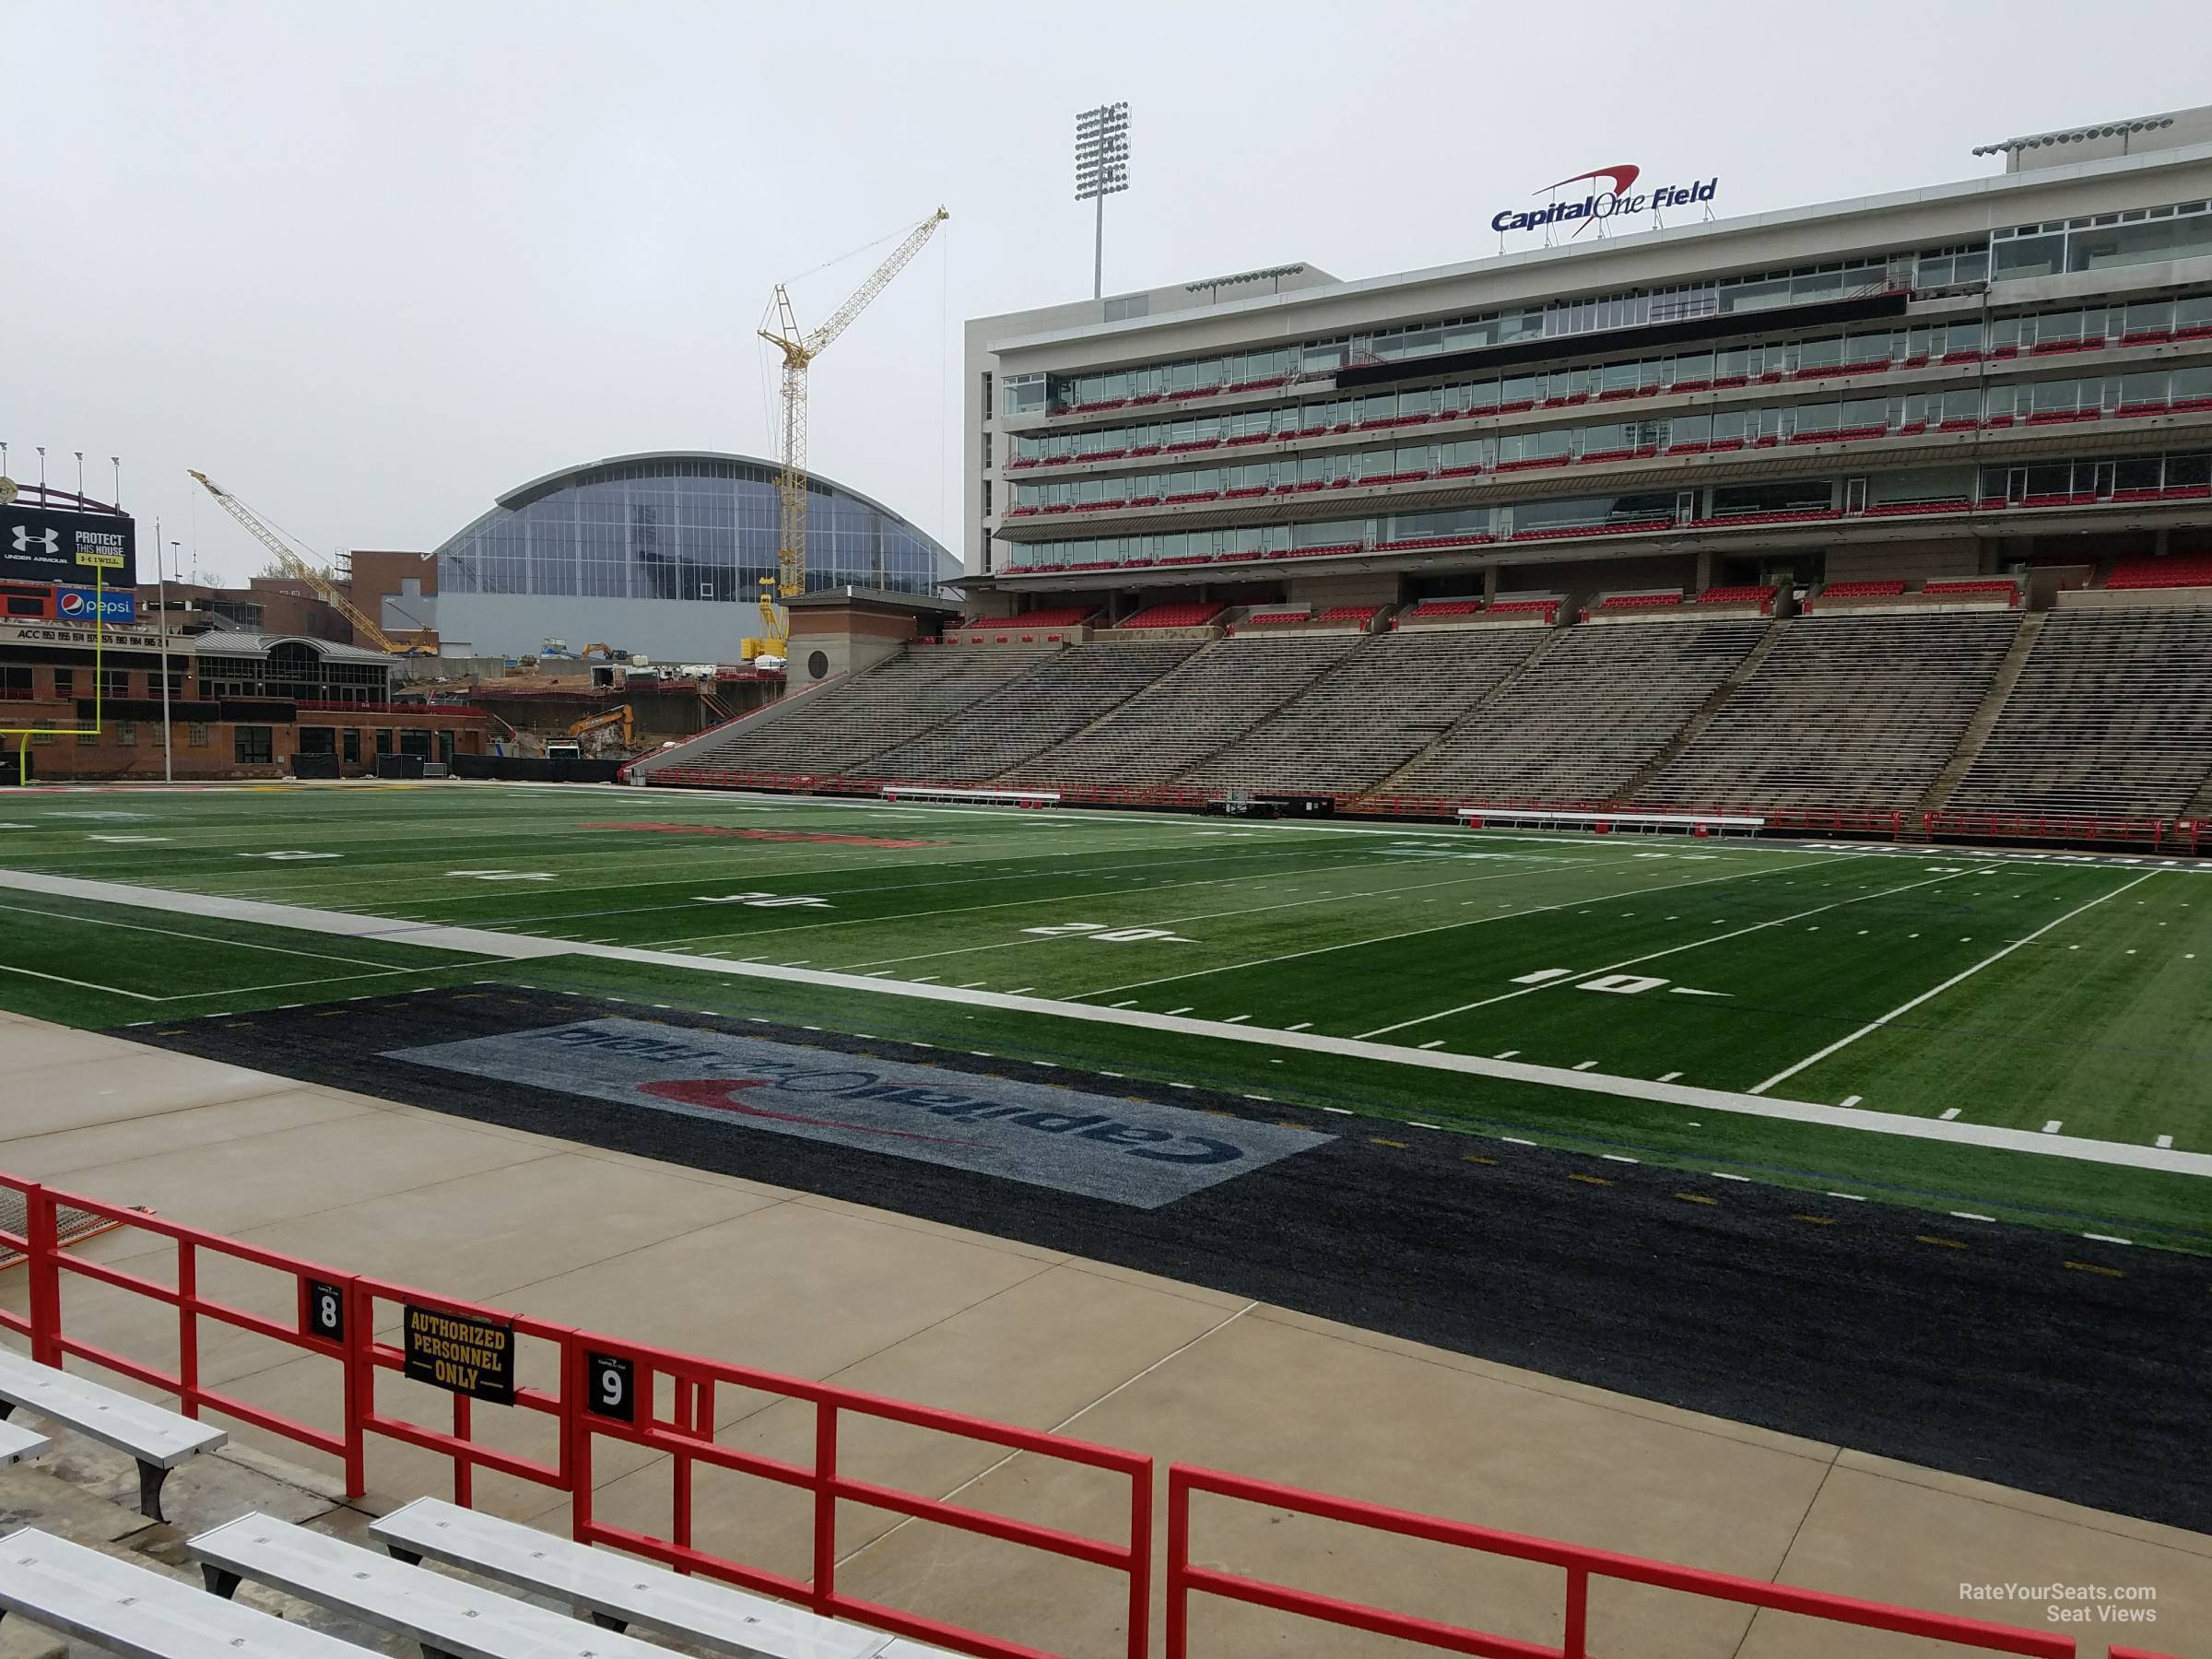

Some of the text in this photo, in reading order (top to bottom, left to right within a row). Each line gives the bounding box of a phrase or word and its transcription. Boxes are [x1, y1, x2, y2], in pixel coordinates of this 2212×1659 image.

[1652, 177, 1718, 208] Field
[76, 530, 124, 547] PROTECT
[76, 544, 94, 553] THIS
[87, 600, 130, 615] pepsi
[18, 629, 41, 639] ACC
[42, 630, 55, 640] 1953
[73, 633, 85, 641] 1974
[1019, 922, 1176, 942] 20
[1508, 968, 1672, 994] 10
[322, 1295, 336, 1327] 8
[412, 1312, 505, 1350] AUTHORIZED
[414, 1333, 501, 1371] PERSONNEL
[435, 1359, 477, 1390] ONLY
[602, 1370, 622, 1406] 9
[13, 1454, 20, 1464] B
